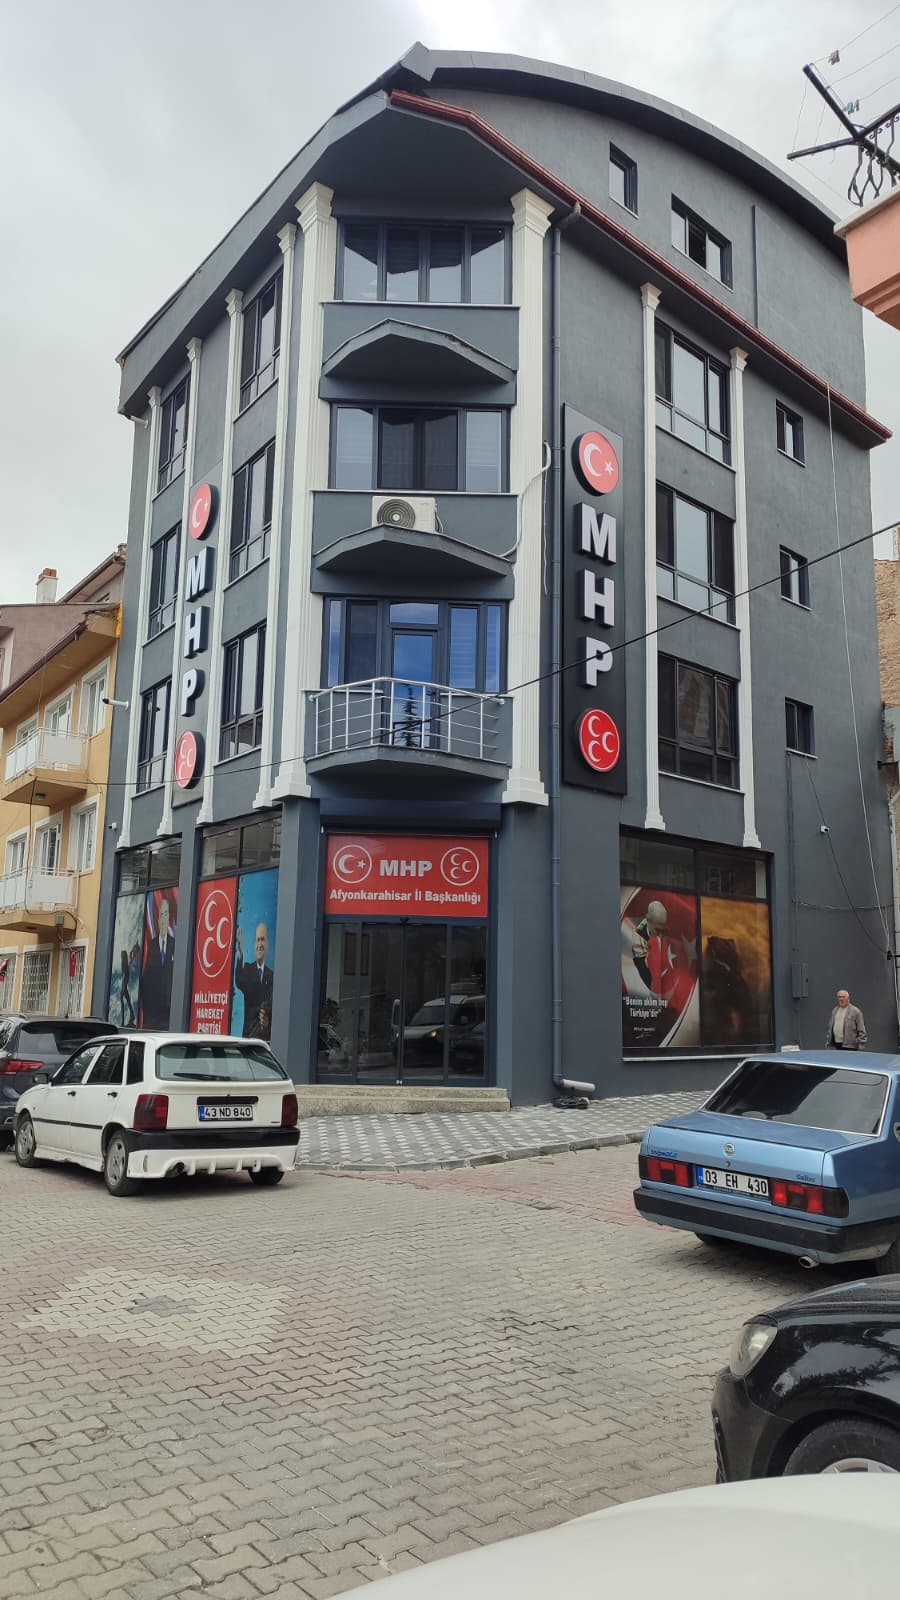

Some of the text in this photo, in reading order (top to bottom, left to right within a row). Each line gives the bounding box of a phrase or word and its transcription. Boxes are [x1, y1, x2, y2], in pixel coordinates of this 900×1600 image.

[579, 502, 617, 687] MHP
[181, 546, 211, 716] MHP
[379, 859, 433, 877] MHP
[330, 888, 481, 904] Afyonkarahisar İl Başkanlığı
[194, 990, 228, 1006] MİLLİYETÇİ
[196, 1007, 224, 1020] HAREKET
[197, 1021, 221, 1035] PARTİSİ
[205, 1107, 251, 1117] 43 ND 840
[704, 1169, 718, 1185] 03
[725, 1173, 738, 1189] EH
[747, 1177, 767, 1195] 430
